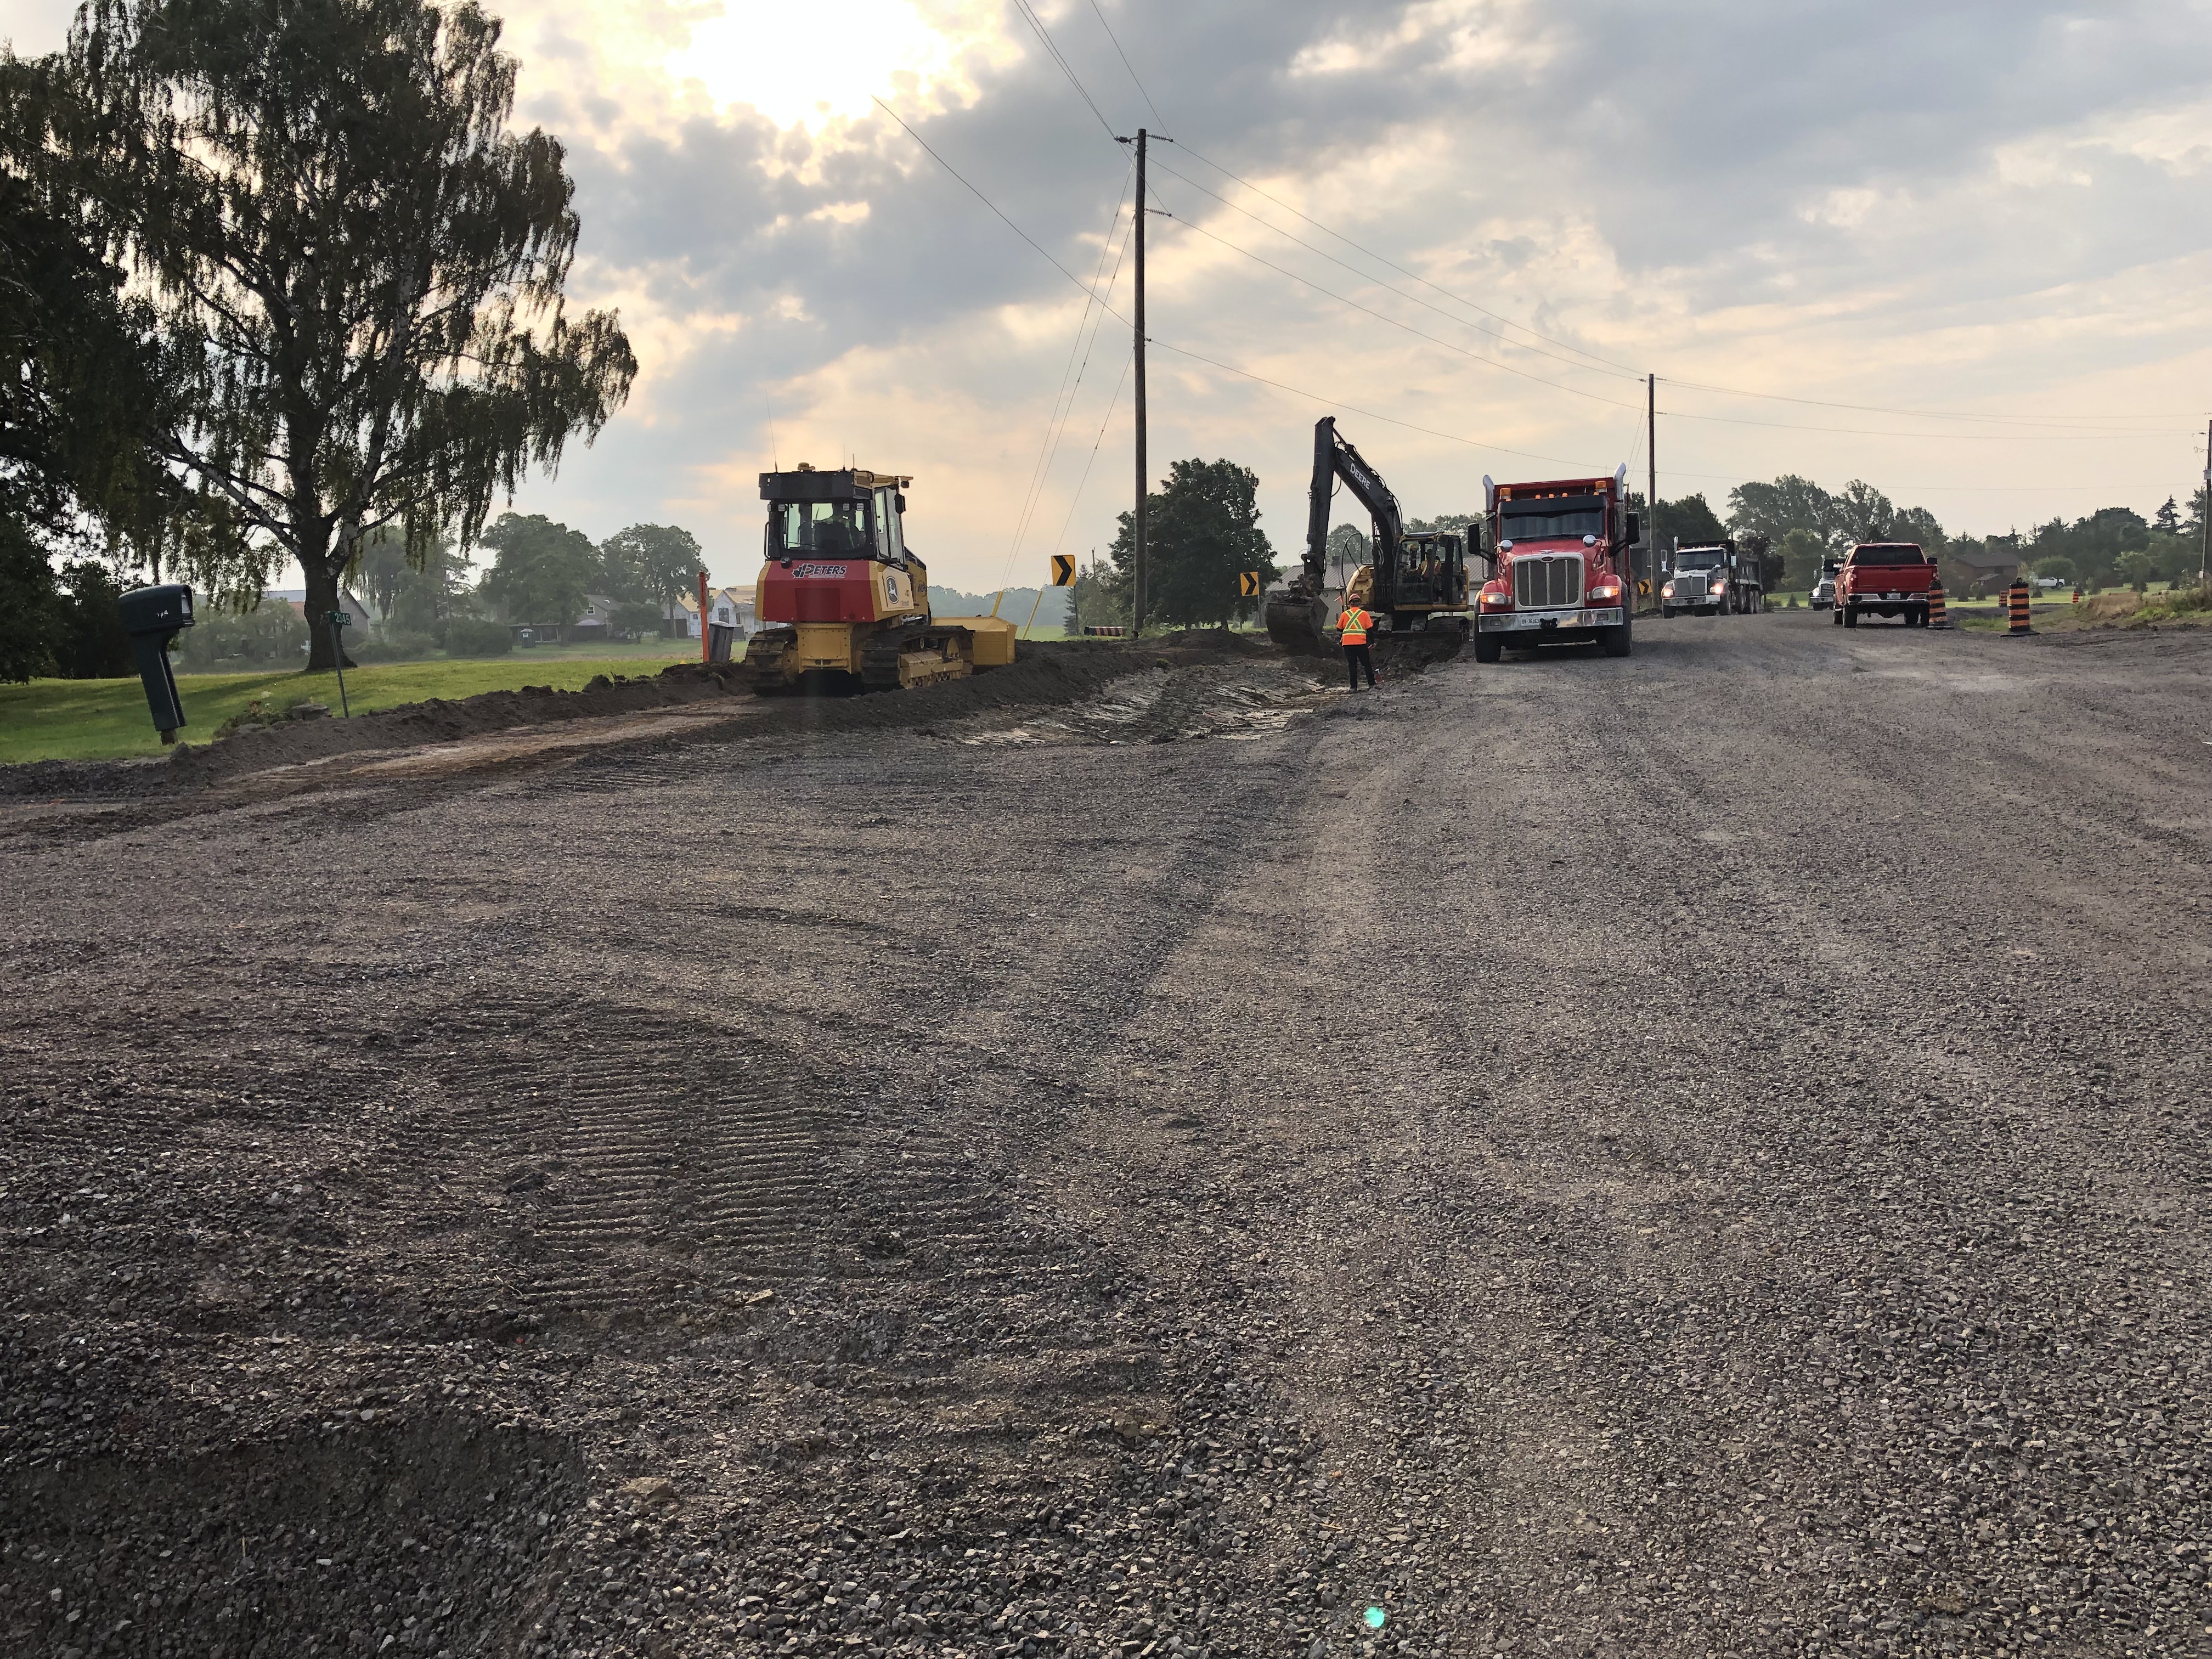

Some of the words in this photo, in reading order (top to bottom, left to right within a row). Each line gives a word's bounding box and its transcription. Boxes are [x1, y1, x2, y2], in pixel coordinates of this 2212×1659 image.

[1350, 462, 1370, 490] DEERE
[799, 563, 847, 578] PETERS
[335, 612, 351, 625] 2345
